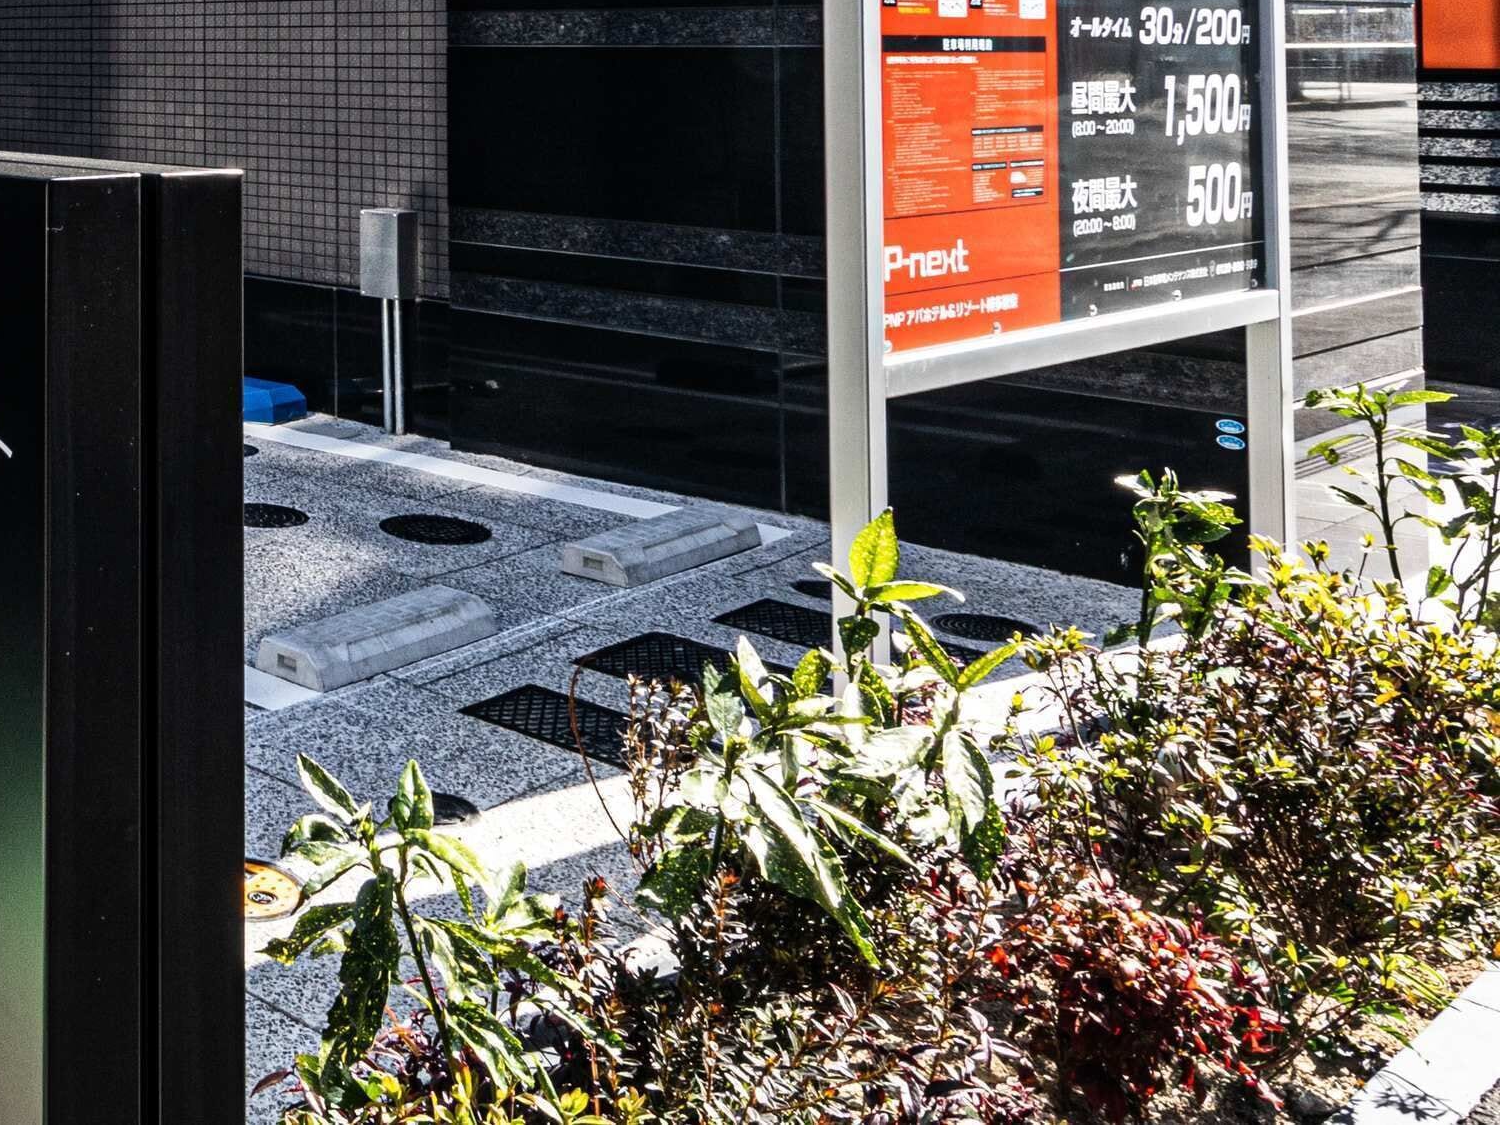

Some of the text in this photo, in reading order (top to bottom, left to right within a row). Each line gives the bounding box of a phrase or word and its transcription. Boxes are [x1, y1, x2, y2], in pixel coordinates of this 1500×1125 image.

[1069, 16, 1133, 38] オールタイム
[1071, 79, 1137, 115] 昼間最大
[1071, 175, 1138, 215] 夜間最大
[883, 238, 970, 282] P-next
